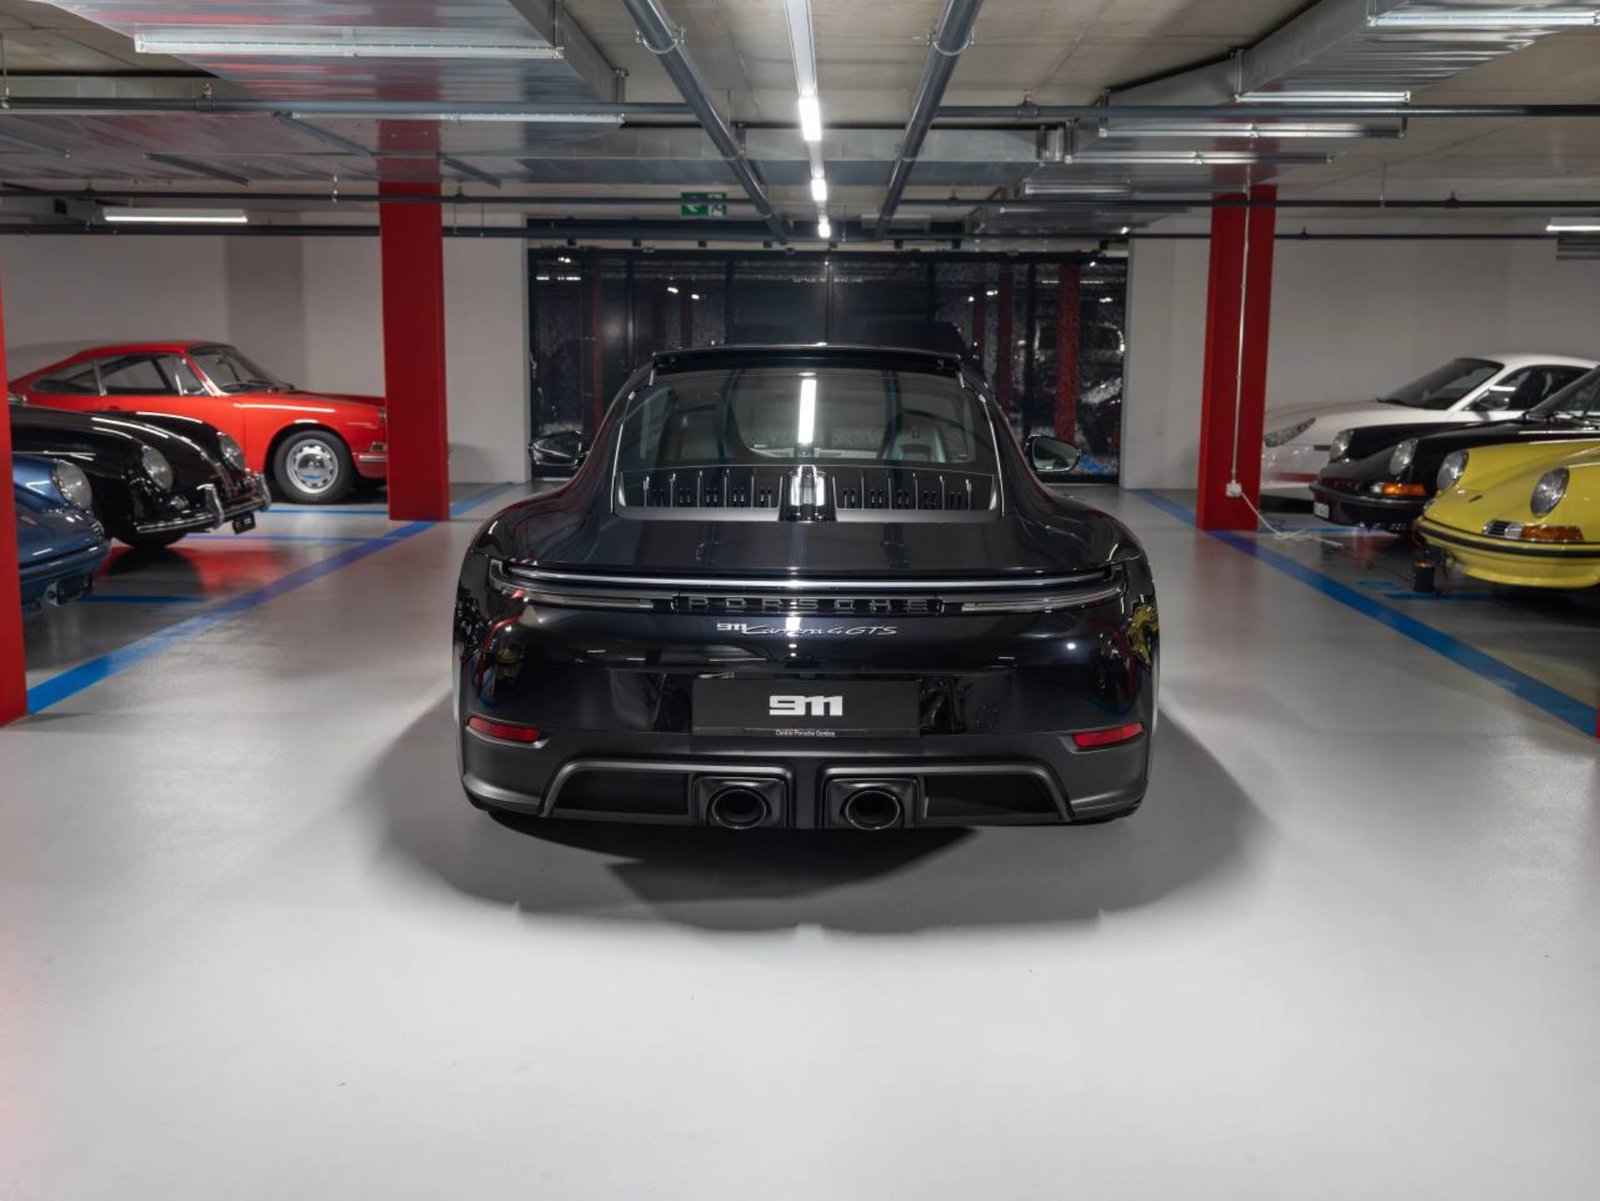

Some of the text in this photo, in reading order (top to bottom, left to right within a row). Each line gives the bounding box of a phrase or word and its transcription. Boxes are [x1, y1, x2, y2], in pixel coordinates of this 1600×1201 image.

[688, 597, 929, 613] PORSCHE
[716, 623, 747, 631] 911
[769, 695, 843, 716] 911
